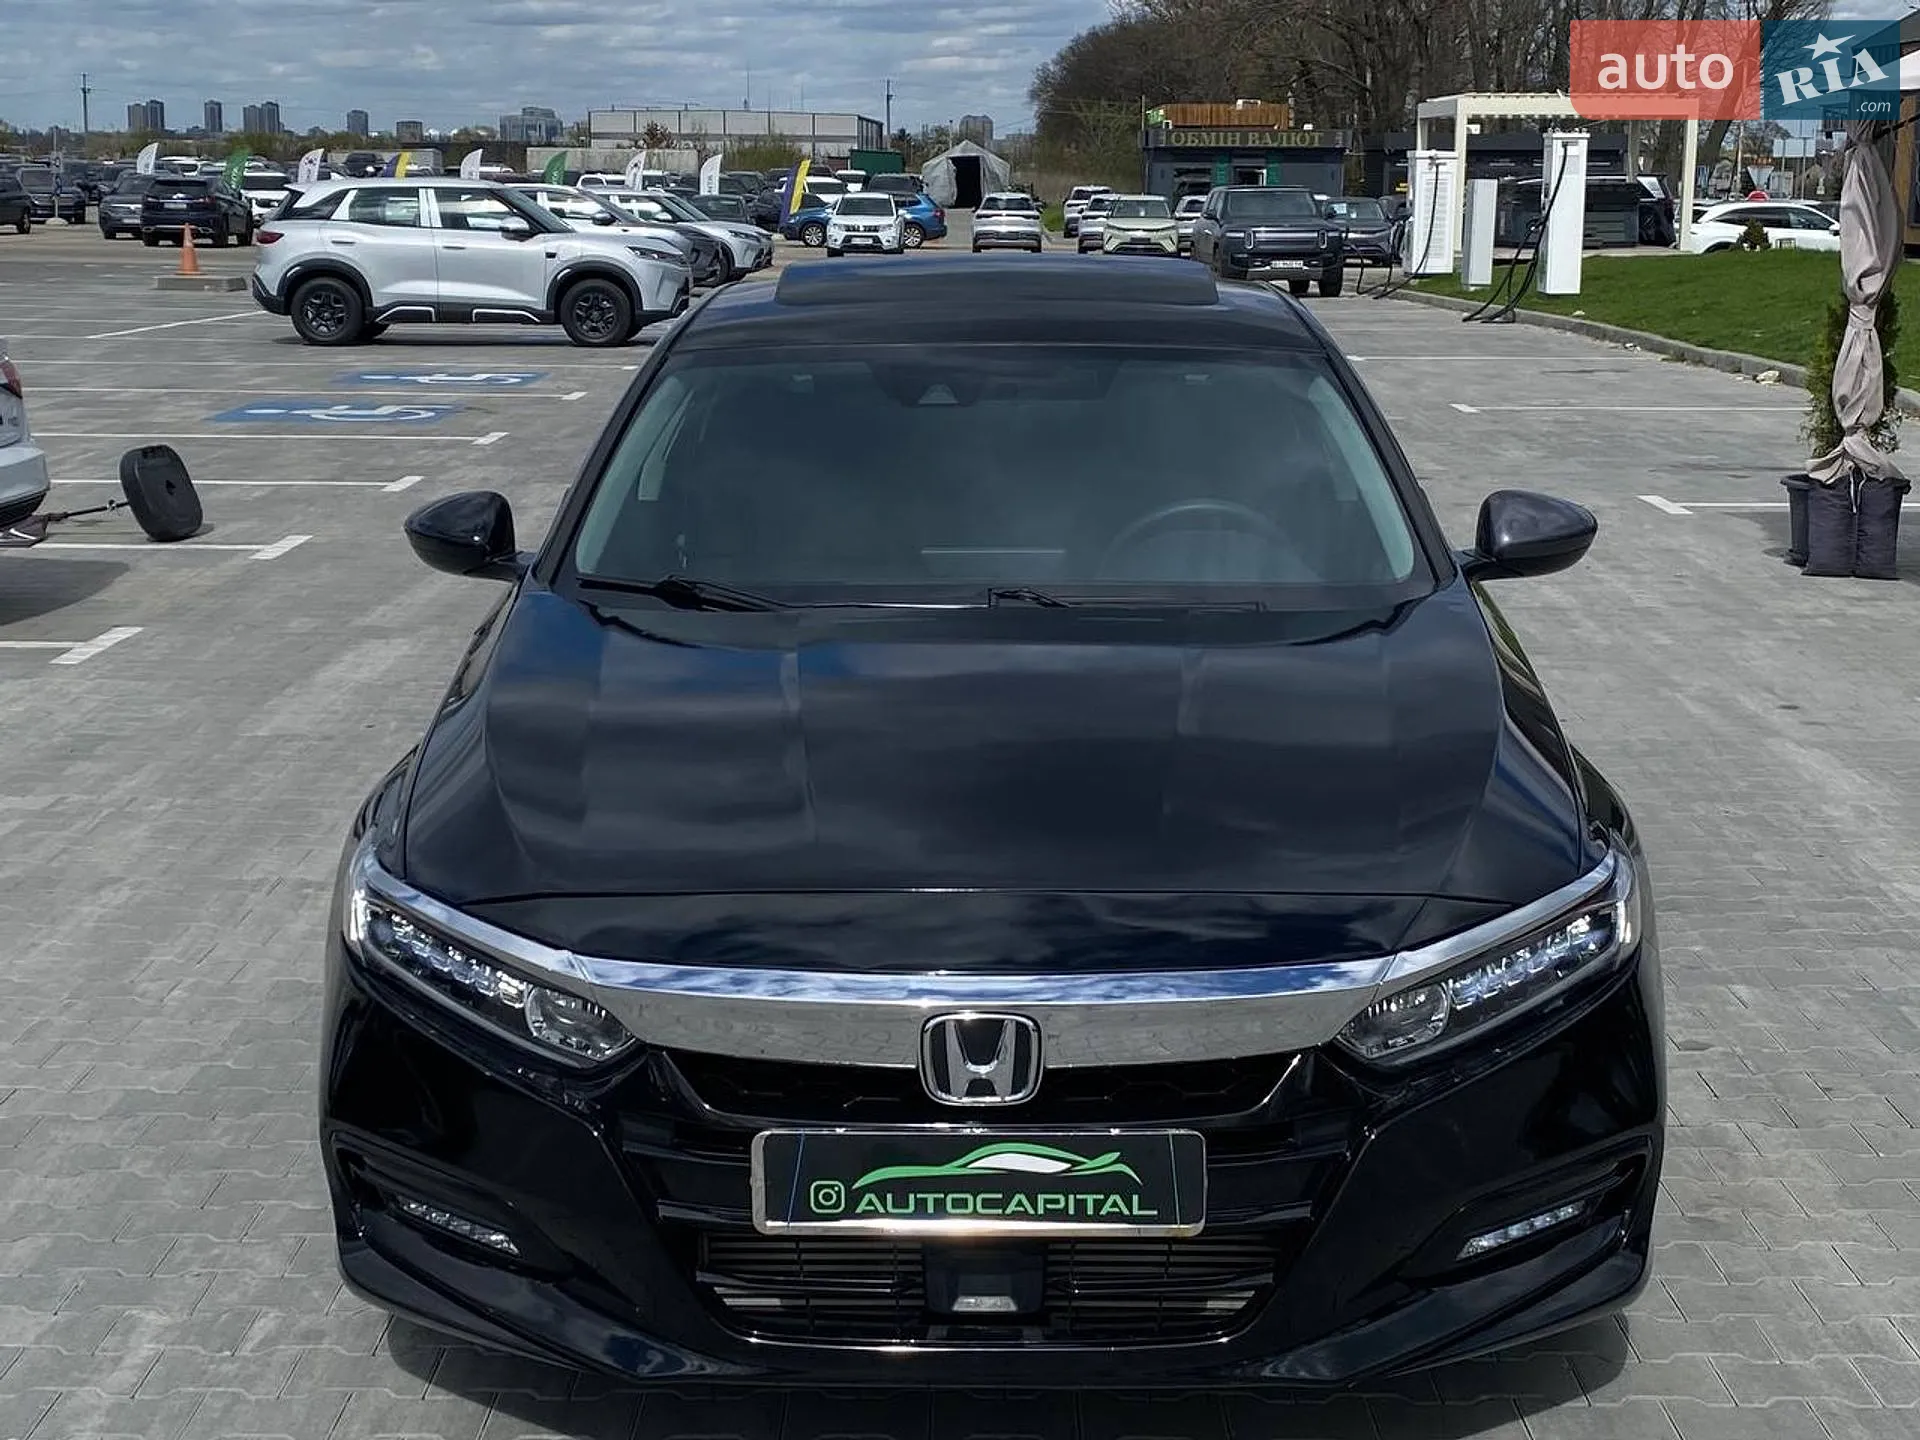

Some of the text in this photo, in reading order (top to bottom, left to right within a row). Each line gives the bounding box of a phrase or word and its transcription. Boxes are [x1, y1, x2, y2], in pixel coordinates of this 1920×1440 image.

[1171, 131, 1325, 147] ОБМІН ВАЛЮТ
[854, 1192, 1159, 1216] AUTOCAPITAL
